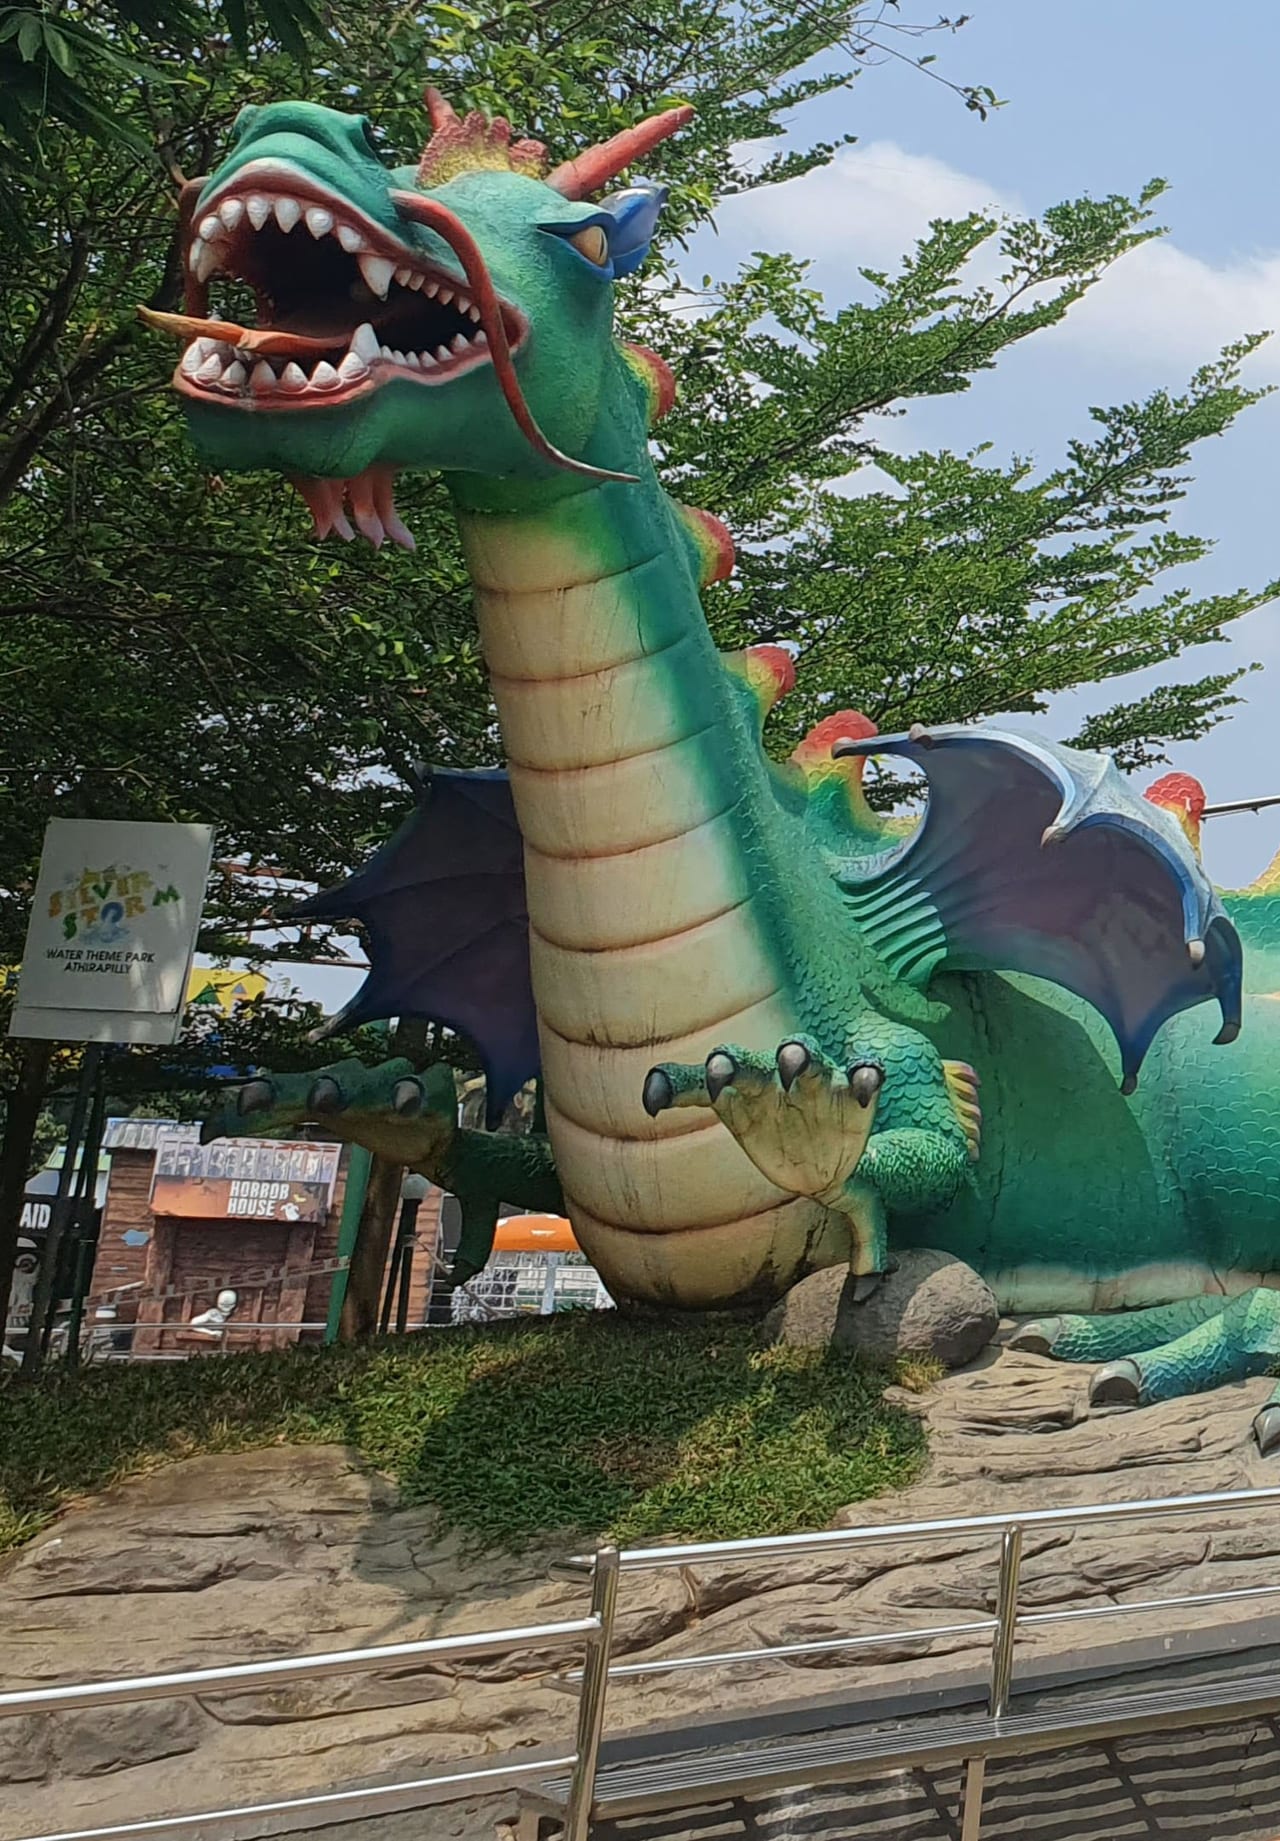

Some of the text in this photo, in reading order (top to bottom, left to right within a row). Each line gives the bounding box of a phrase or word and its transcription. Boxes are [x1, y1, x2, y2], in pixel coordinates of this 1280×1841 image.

[47, 949, 155, 963] WATER THEME PARK
[64, 961, 131, 974] ATHIRAPILLY
[230, 1180, 290, 1200] HORROR
[227, 1198, 276, 1216] HOUSE
